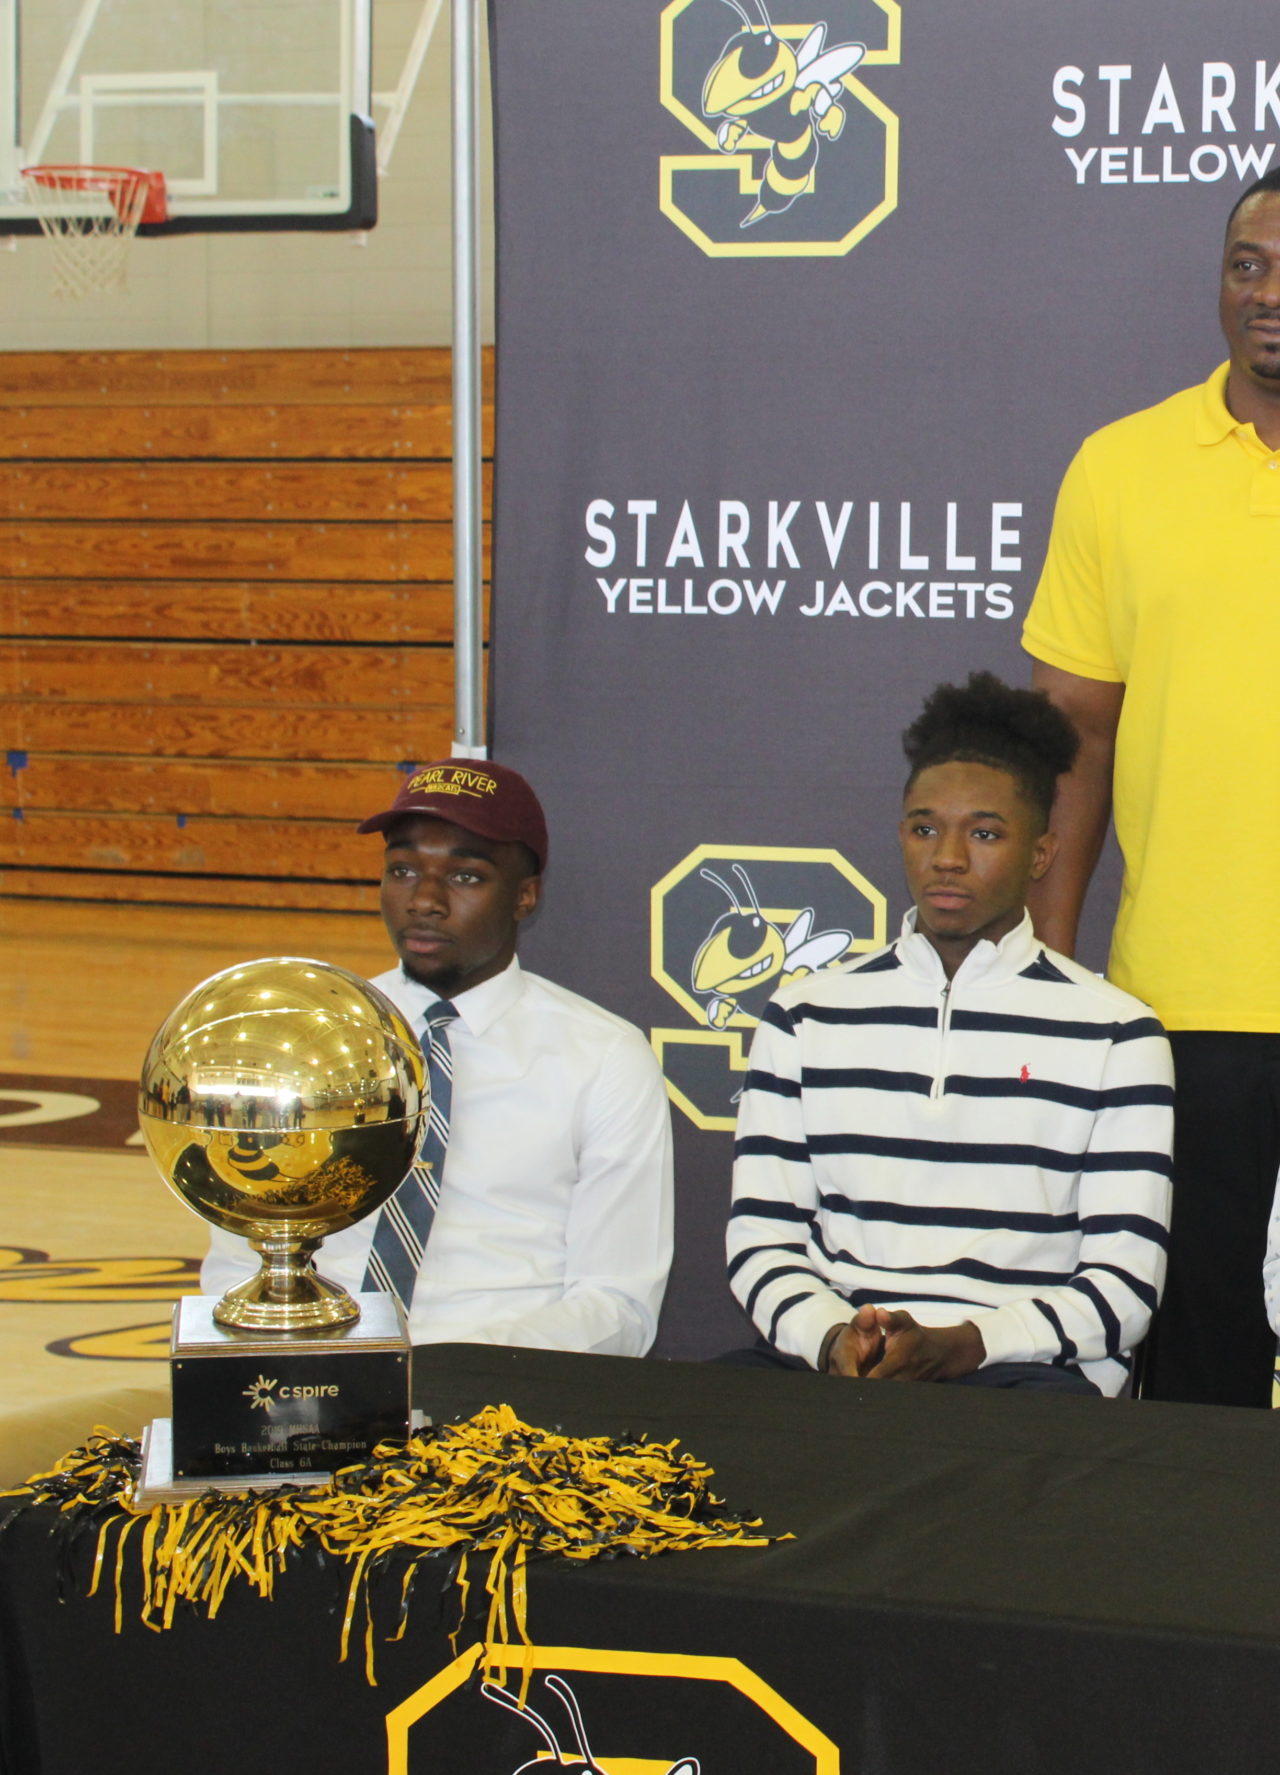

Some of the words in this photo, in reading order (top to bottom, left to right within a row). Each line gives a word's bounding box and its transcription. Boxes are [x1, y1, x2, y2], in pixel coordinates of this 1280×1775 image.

[1065, 143, 1276, 184] YELLOW
[584, 499, 1024, 572] STARKVILLE
[596, 578, 788, 615] YELLOW
[800, 580, 1014, 620] JACKETS
[407, 769, 445, 789] PEARL
[451, 770, 497, 795] RIVER
[213, 1442, 236, 1455] Boys
[320, 1438, 367, 1452] Champion
[269, 1457, 295, 1469] Class
[299, 1456, 313, 1468] 6A
